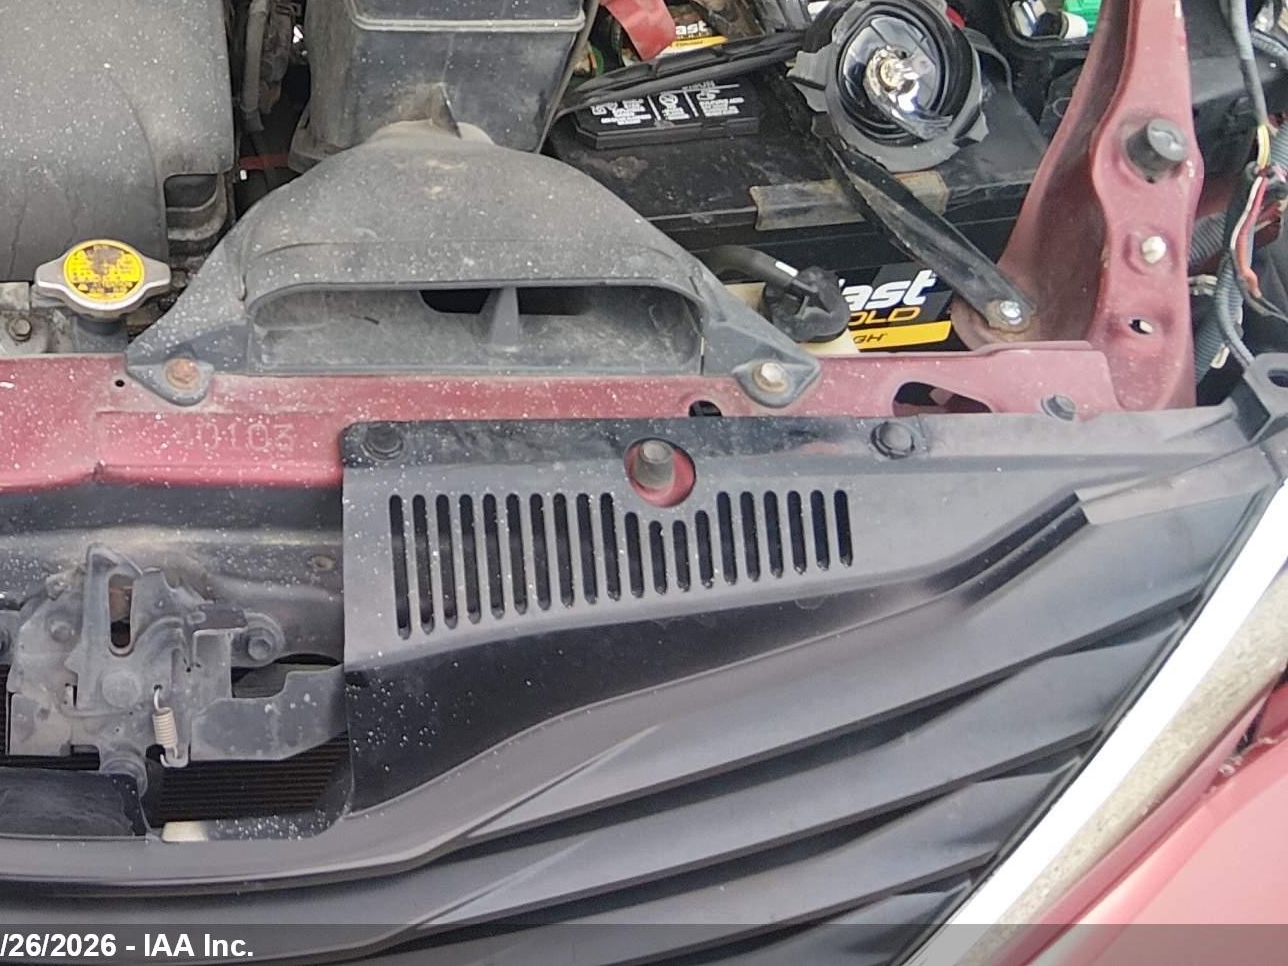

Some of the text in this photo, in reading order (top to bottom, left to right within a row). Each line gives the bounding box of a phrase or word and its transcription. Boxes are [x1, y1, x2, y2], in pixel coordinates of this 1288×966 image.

[675, 19, 708, 35] ast
[838, 269, 937, 312] ast
[847, 306, 921, 326] OLD
